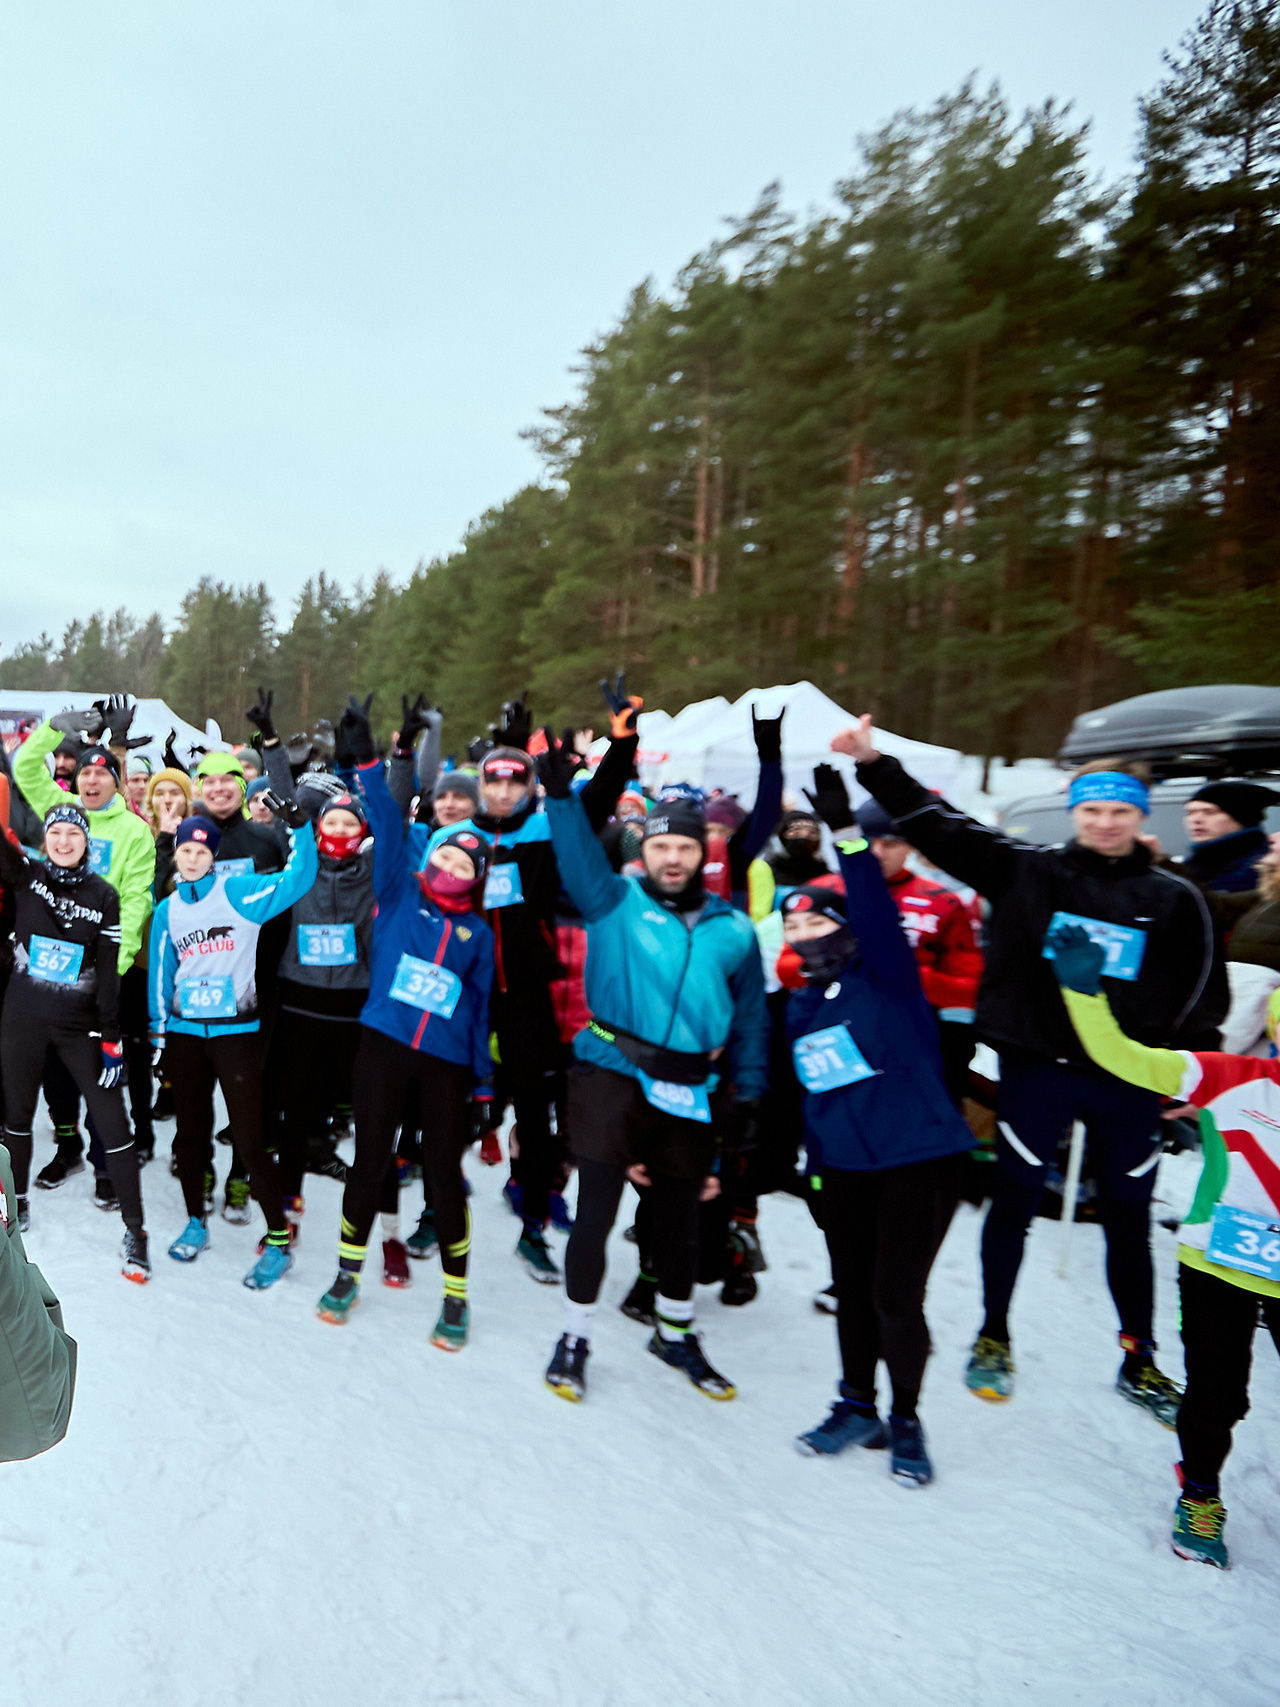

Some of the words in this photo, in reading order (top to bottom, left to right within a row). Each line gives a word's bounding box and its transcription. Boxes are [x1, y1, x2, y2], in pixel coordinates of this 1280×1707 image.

[177, 929, 206, 953] HARD
[198, 940, 236, 955] CLUB
[308, 937, 346, 955] 318
[37, 951, 72, 972] 567
[188, 988, 223, 1007] 469
[407, 973, 449, 1002] 373
